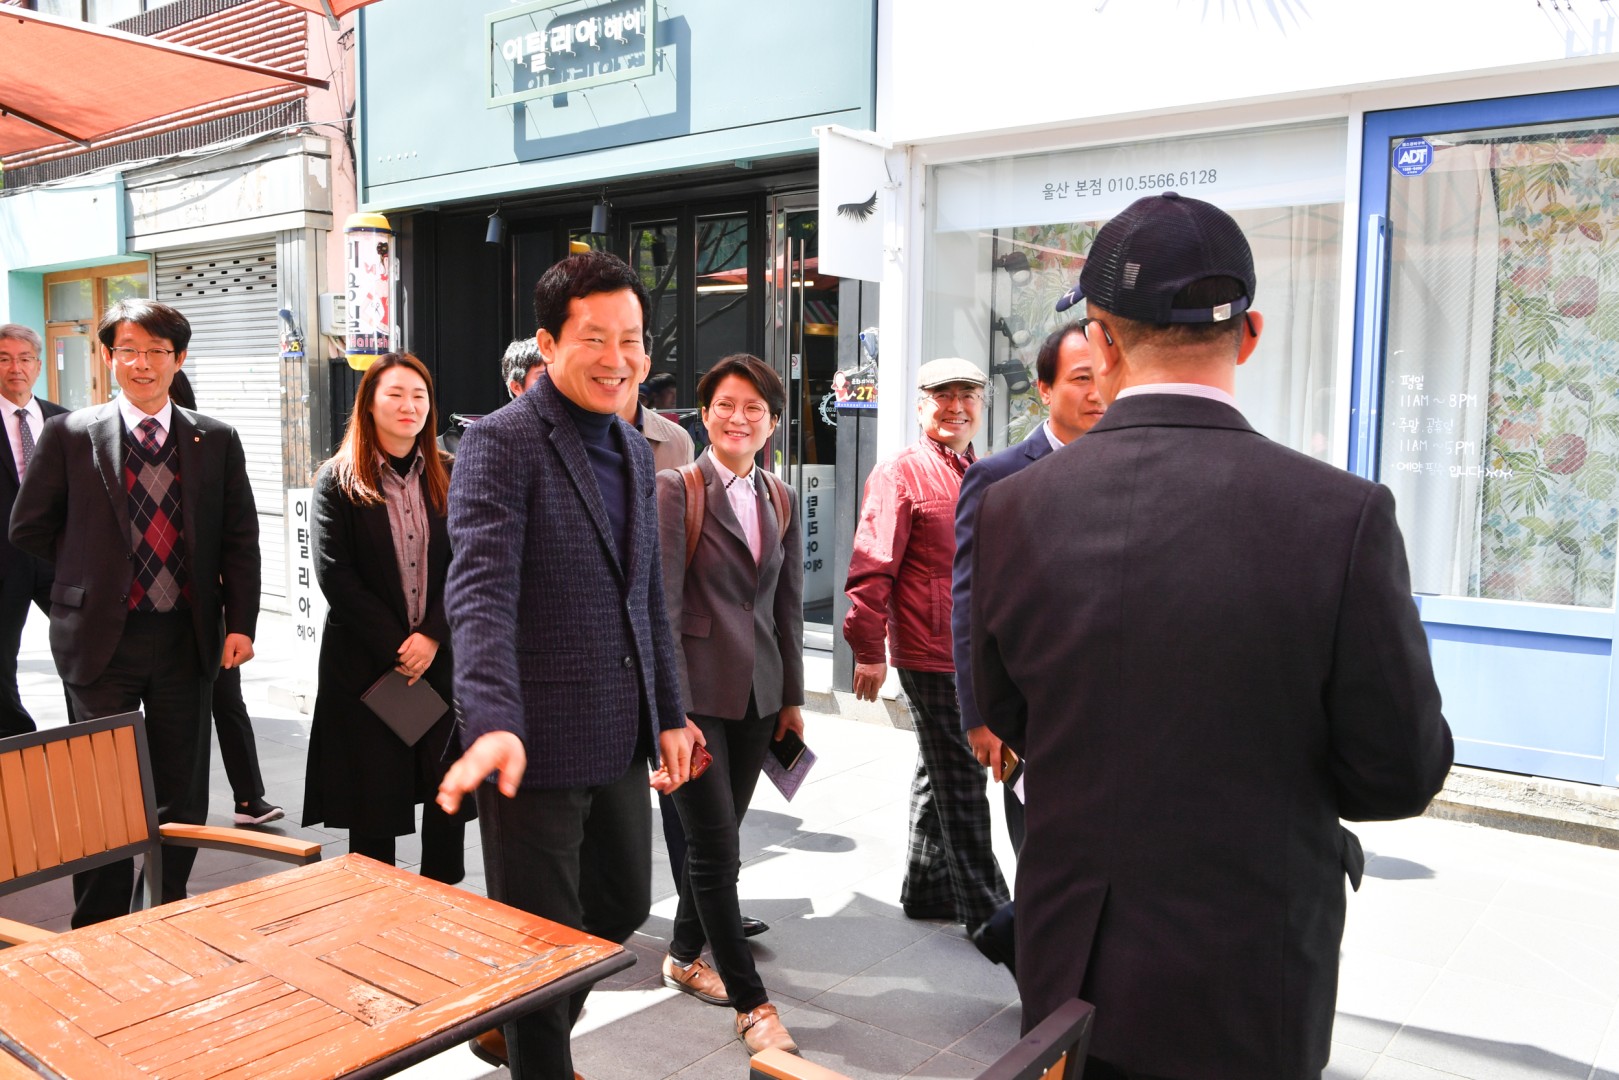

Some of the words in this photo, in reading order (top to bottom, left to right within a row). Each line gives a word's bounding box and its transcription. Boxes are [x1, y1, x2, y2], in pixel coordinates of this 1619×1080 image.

[502, 17, 598, 73] 이탈리아
[1399, 149, 1427, 164] ADT
[1042, 181, 1070, 200] 울산
[1074, 178, 1102, 197] 본점
[1107, 169, 1218, 193] 010.5566.6128
[1400, 375, 1425, 390] 평일
[856, 386, 873, 400] 27
[1401, 395, 1429, 408] 11AM
[1449, 394, 1477, 408] 8PM
[1400, 440, 1428, 452] 11AM
[295, 500, 311, 618] 이탈리아
[296, 624, 316, 643] 헤어
